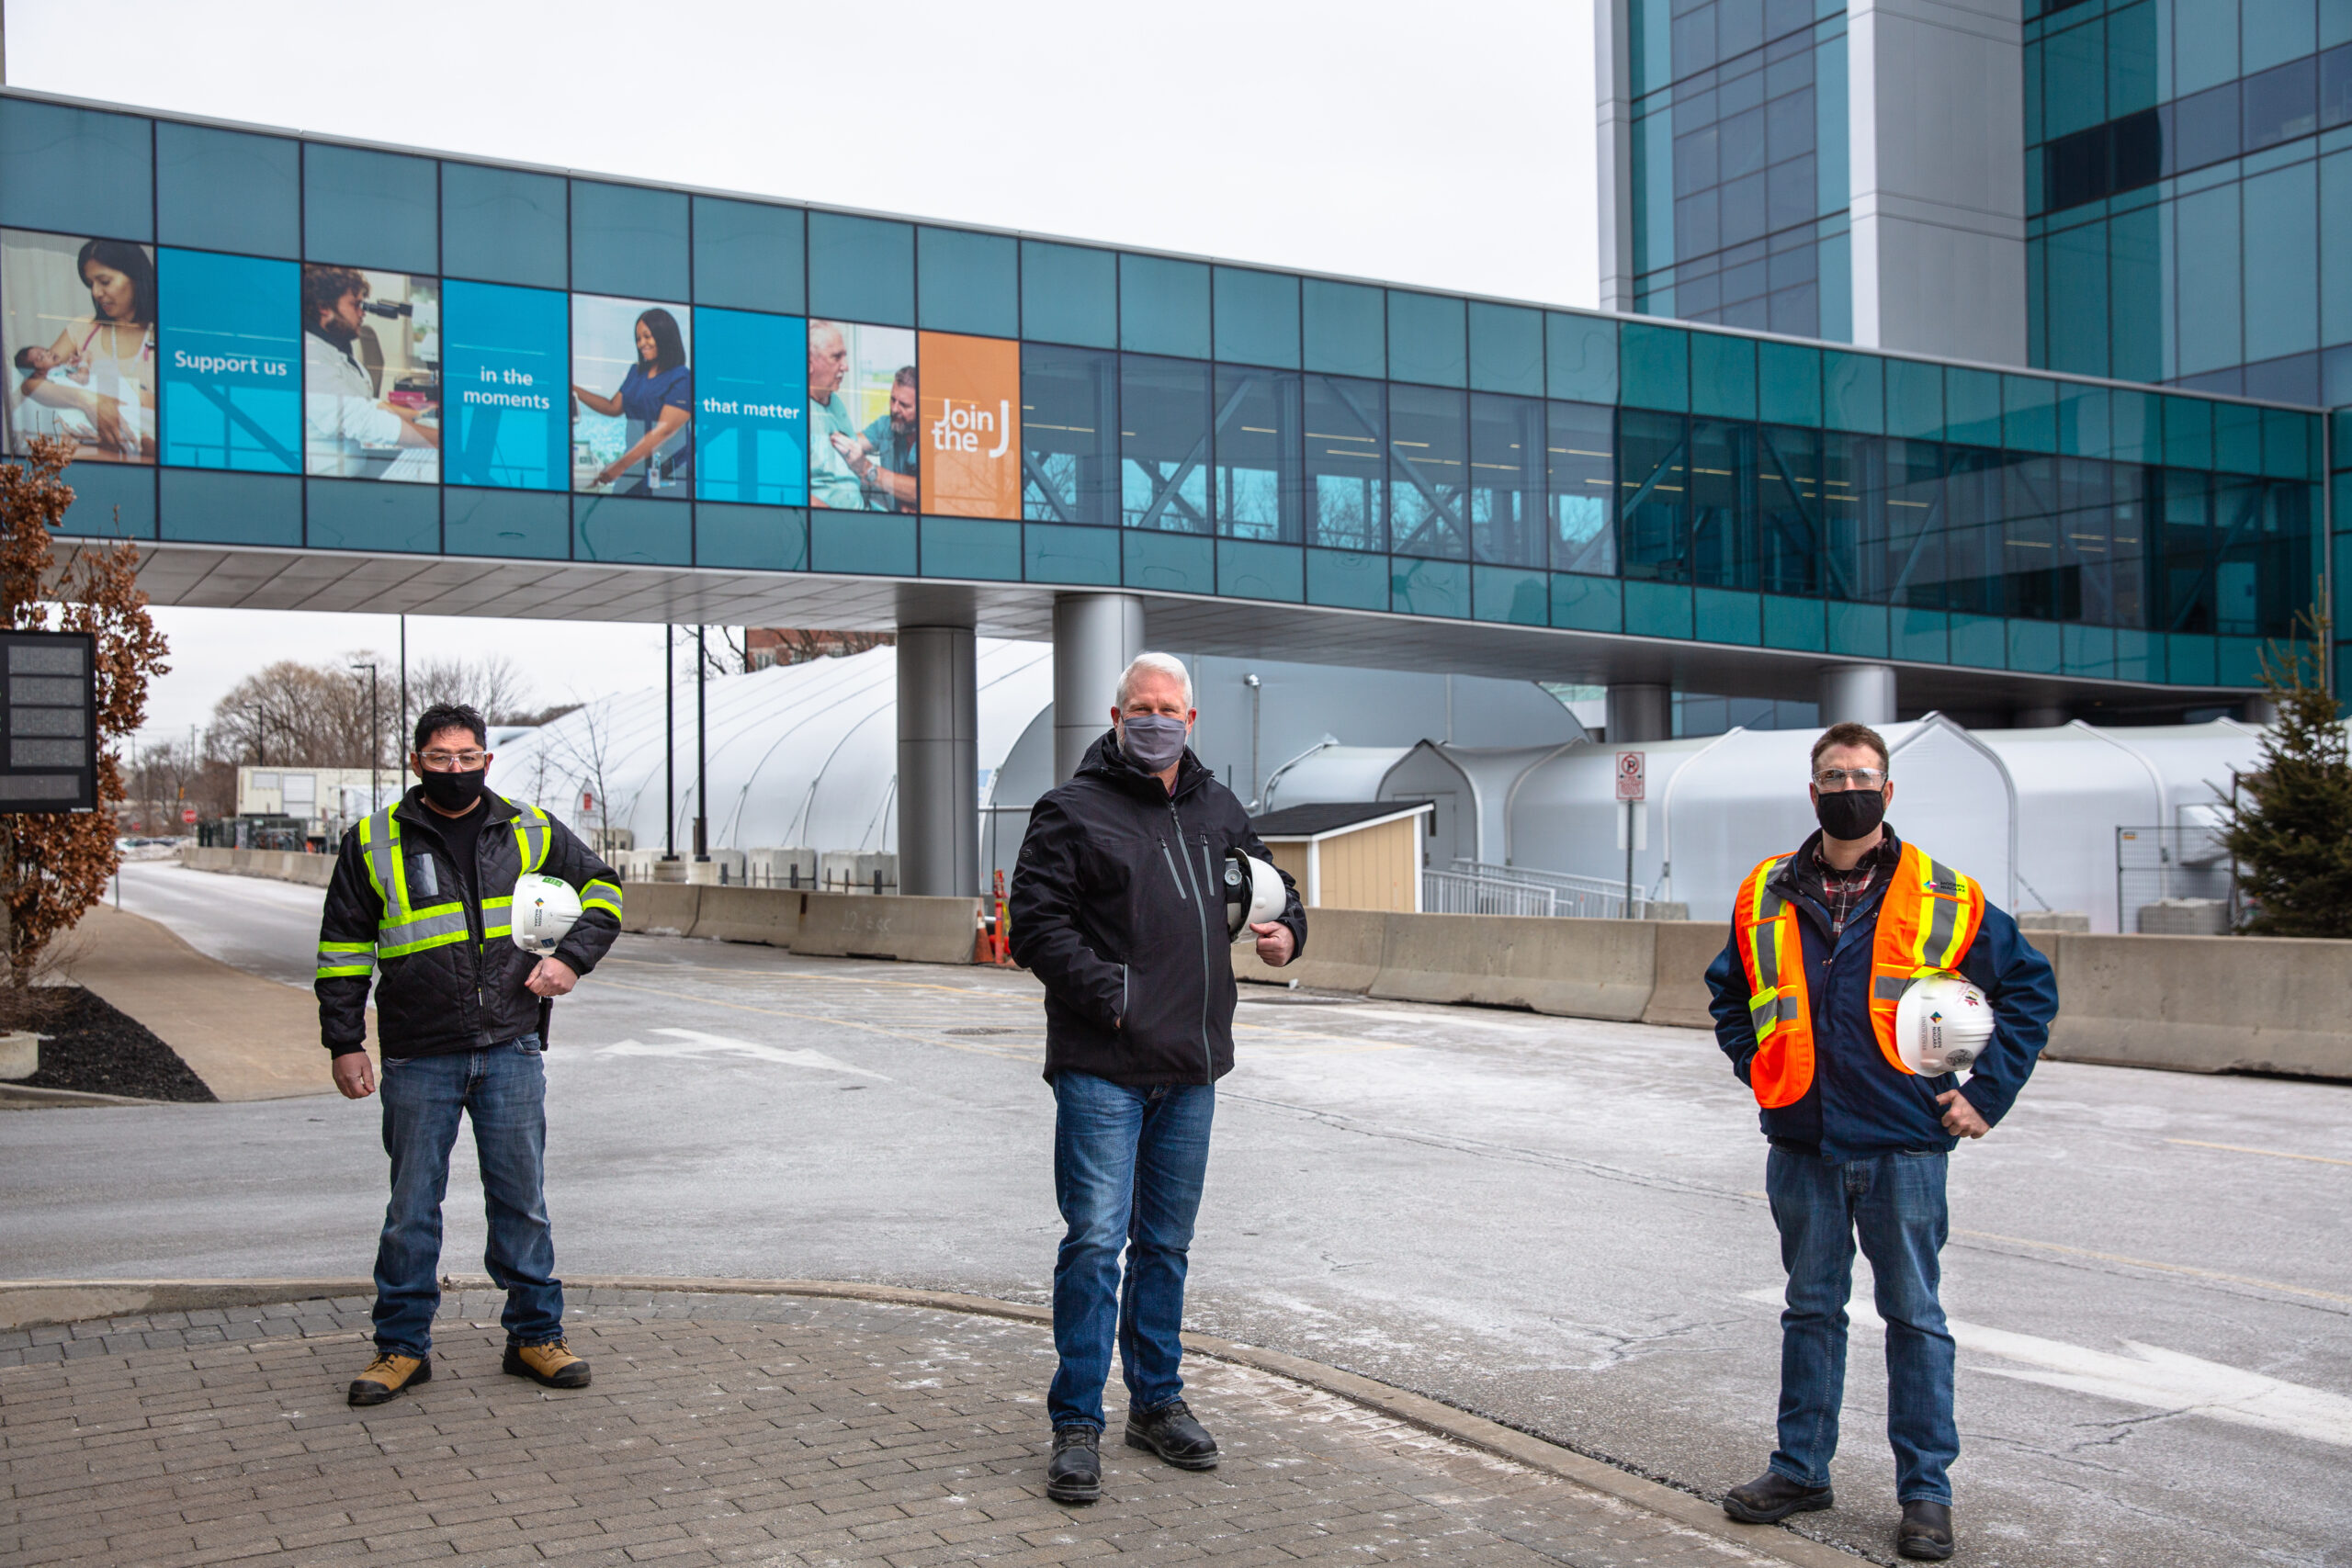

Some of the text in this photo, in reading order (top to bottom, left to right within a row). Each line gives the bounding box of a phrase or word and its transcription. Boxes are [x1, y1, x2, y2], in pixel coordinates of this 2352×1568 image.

[175, 350, 288, 377] Support us
[481, 366, 534, 387] in the
[463, 390, 550, 410] moments
[703, 397, 800, 420] that matter
[933, 398, 994, 432] Join
[931, 423, 978, 453] the
[989, 400, 1010, 458] J
